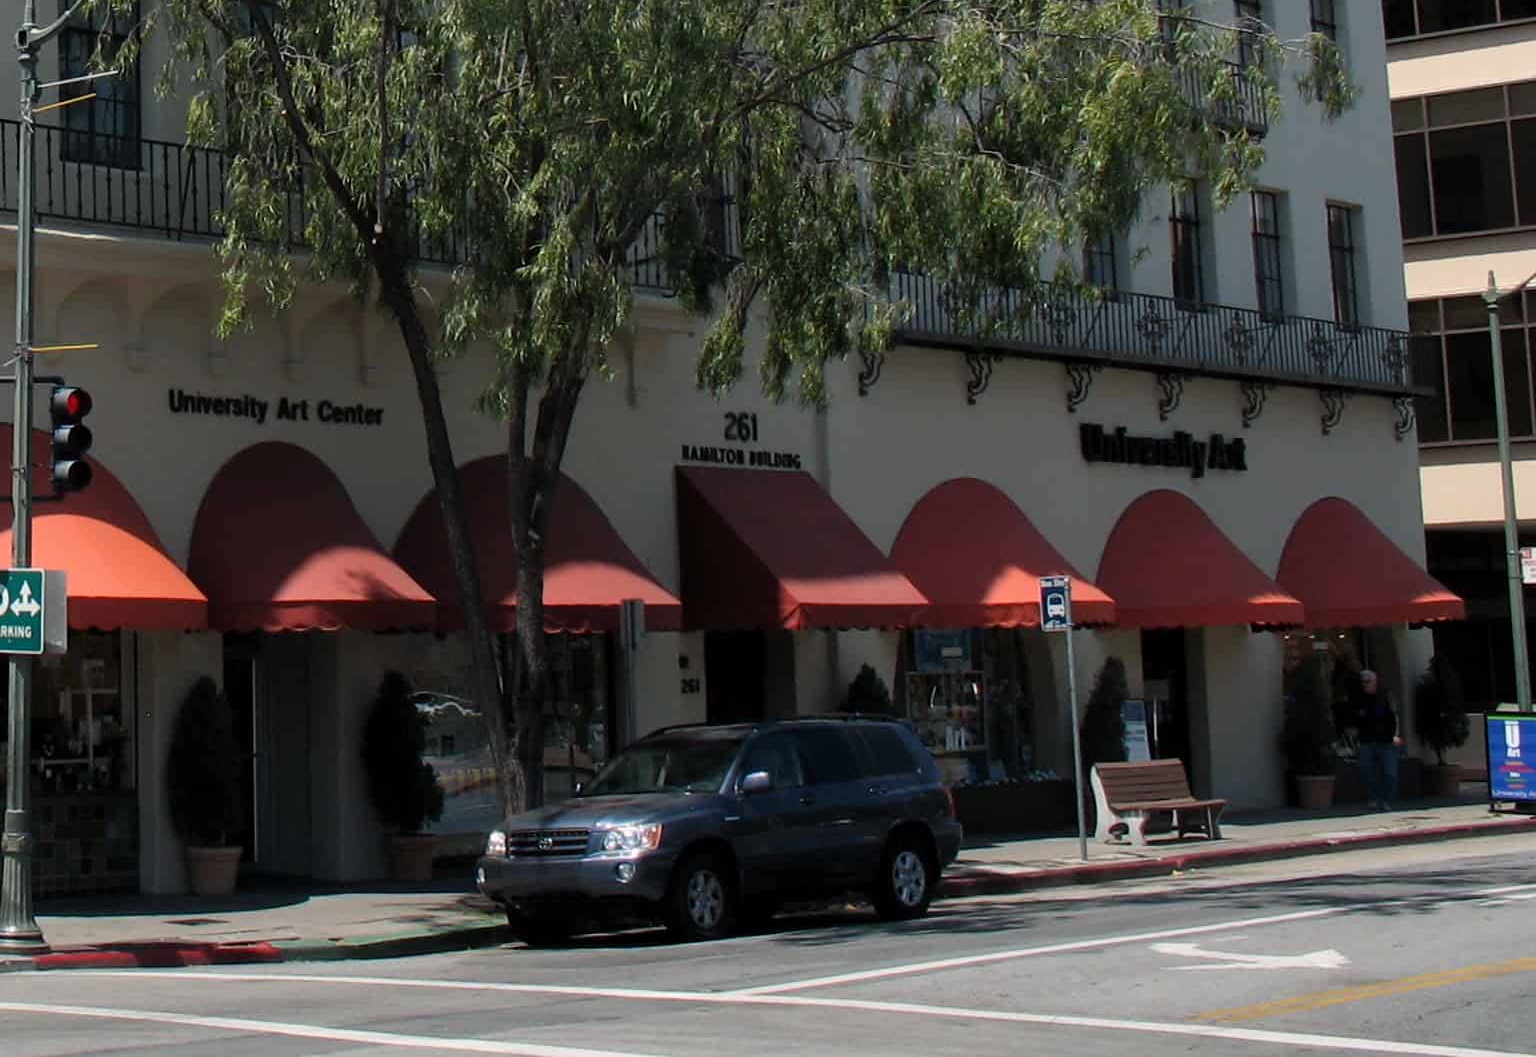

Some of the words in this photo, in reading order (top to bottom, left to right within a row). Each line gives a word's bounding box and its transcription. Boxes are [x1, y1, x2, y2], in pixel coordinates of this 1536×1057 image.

[168, 389, 268, 424] University
[276, 397, 310, 421] Art
[316, 399, 385, 425] Center
[724, 411, 758, 442] 261
[681, 444, 745, 465] HAMILTON
[749, 450, 801, 469] BUILDING
